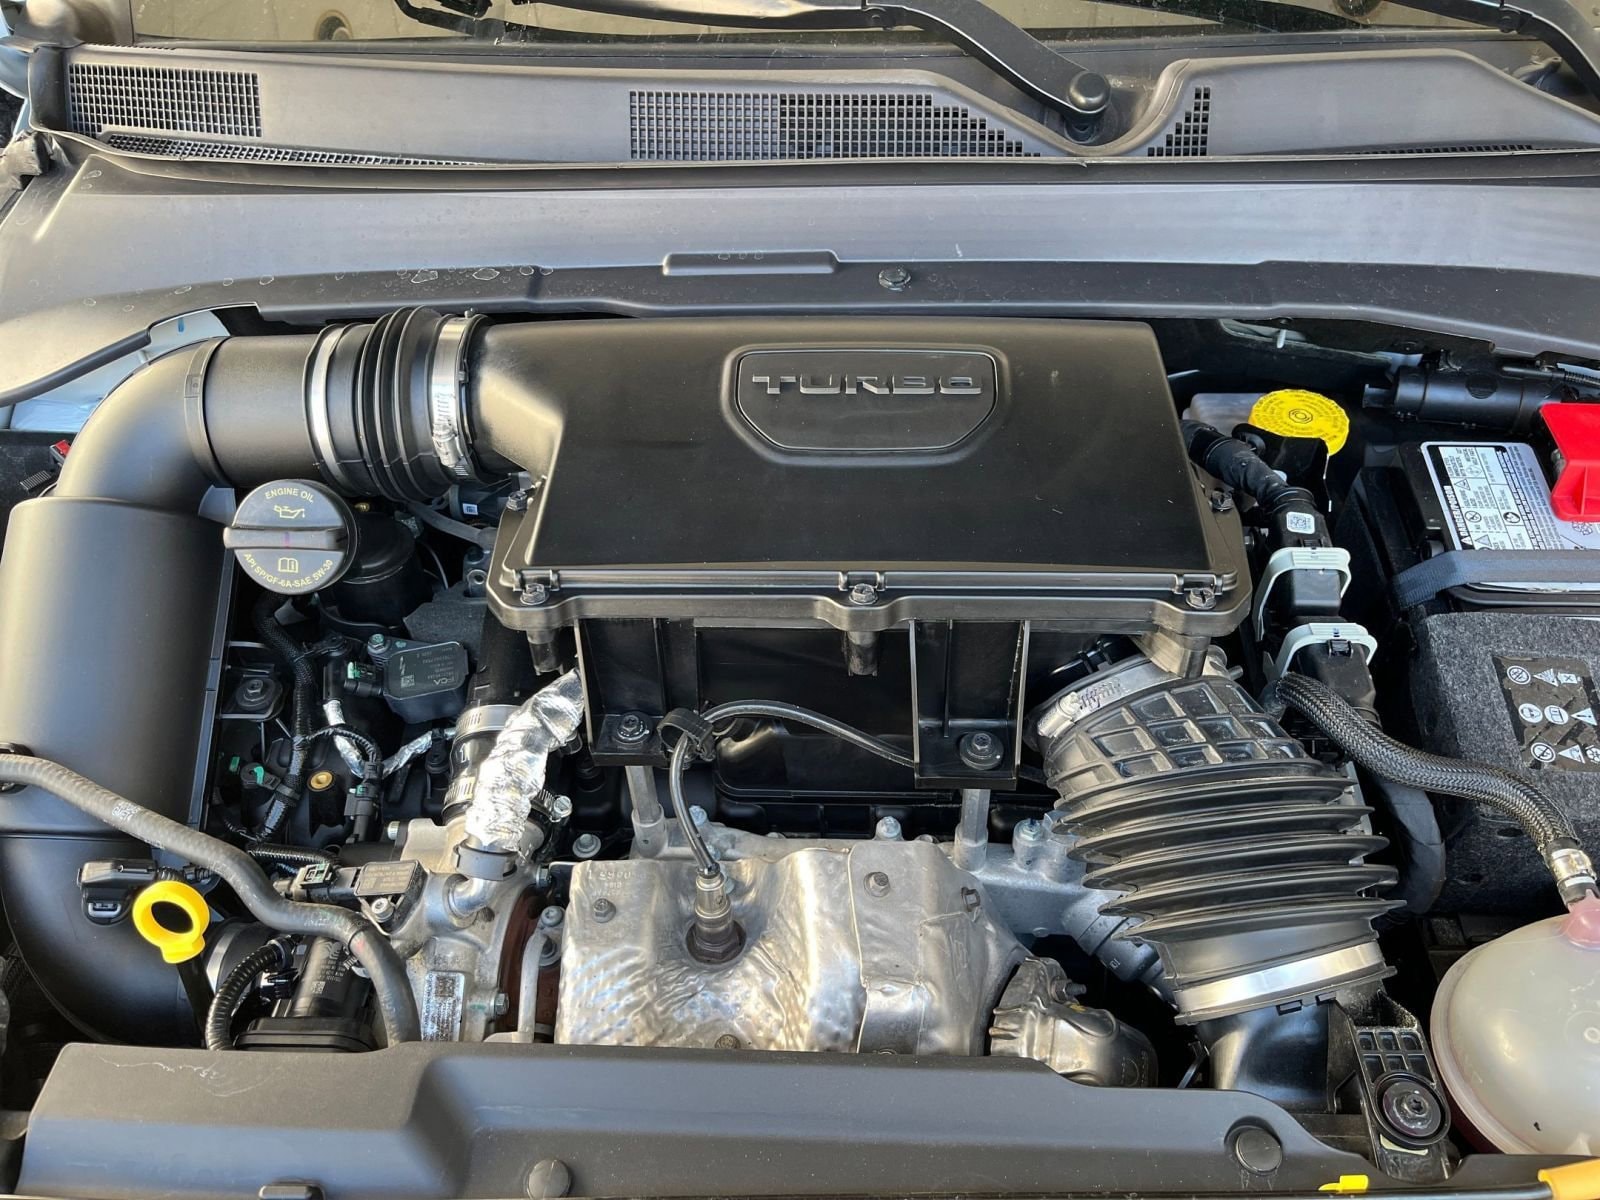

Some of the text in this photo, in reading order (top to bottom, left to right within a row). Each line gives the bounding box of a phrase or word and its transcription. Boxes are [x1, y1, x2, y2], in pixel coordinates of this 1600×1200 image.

[752, 373, 983, 395] TURBO
[264, 487, 315, 504] ENGINE OIL
[243, 552, 334, 588] API SP/GF-6A-SAE 5W-30
